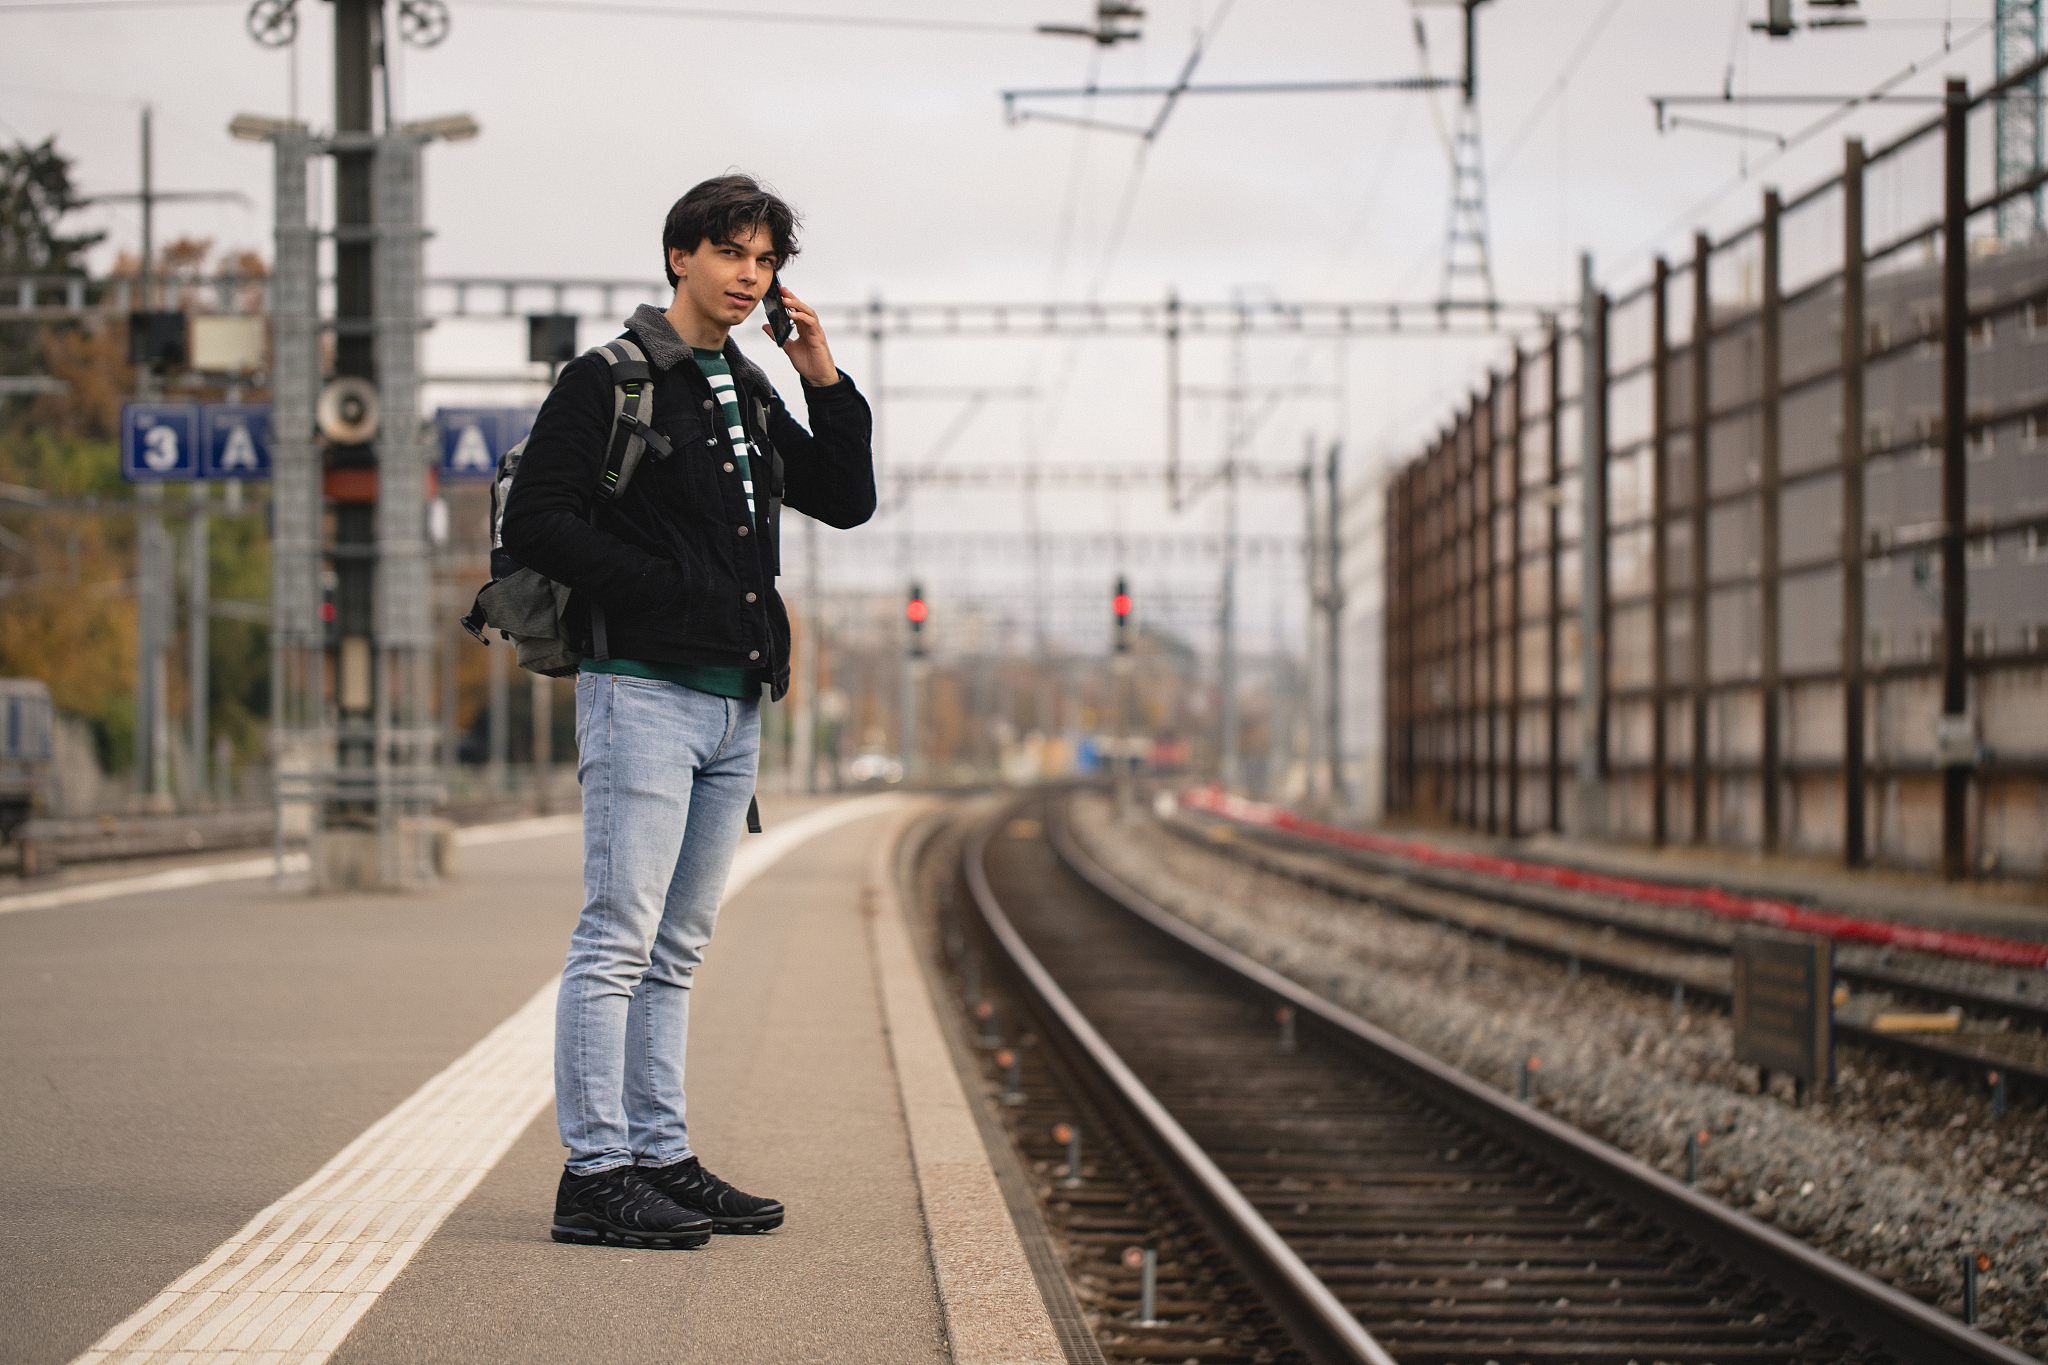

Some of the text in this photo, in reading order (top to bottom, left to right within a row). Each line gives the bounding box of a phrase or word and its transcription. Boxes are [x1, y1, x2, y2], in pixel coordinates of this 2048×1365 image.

[144, 425, 179, 472] 3
[221, 424, 258, 472] A
[452, 424, 491, 472] A
